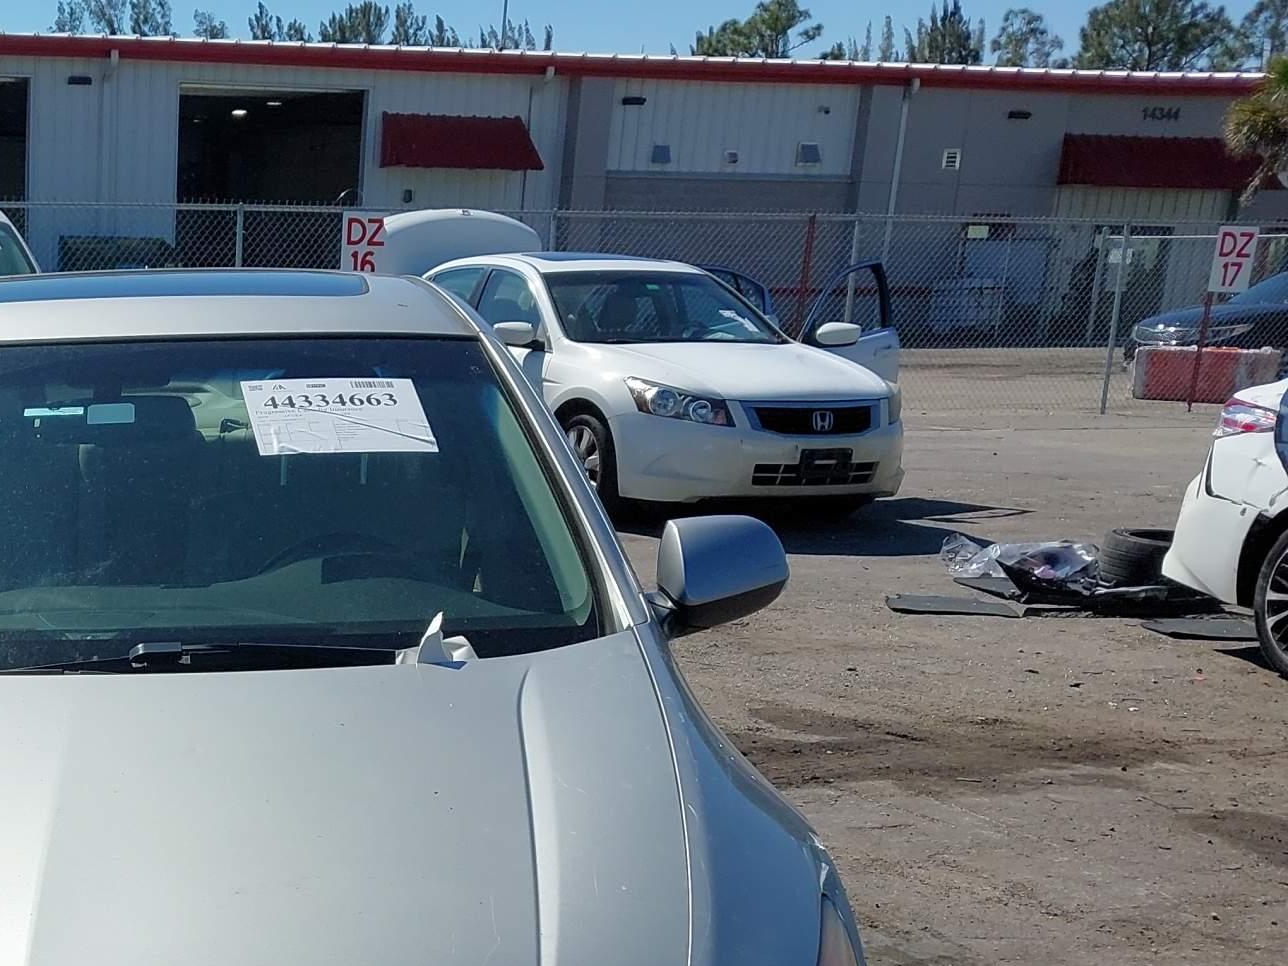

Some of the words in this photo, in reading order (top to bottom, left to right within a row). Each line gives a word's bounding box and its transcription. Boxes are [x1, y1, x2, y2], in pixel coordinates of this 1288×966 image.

[1142, 106, 1181, 121] 14344
[347, 218, 384, 246] DZ
[1219, 231, 1255, 258] DZ
[351, 250, 375, 272] 16
[1222, 262, 1243, 287] 17
[263, 392, 398, 409] 44334663
